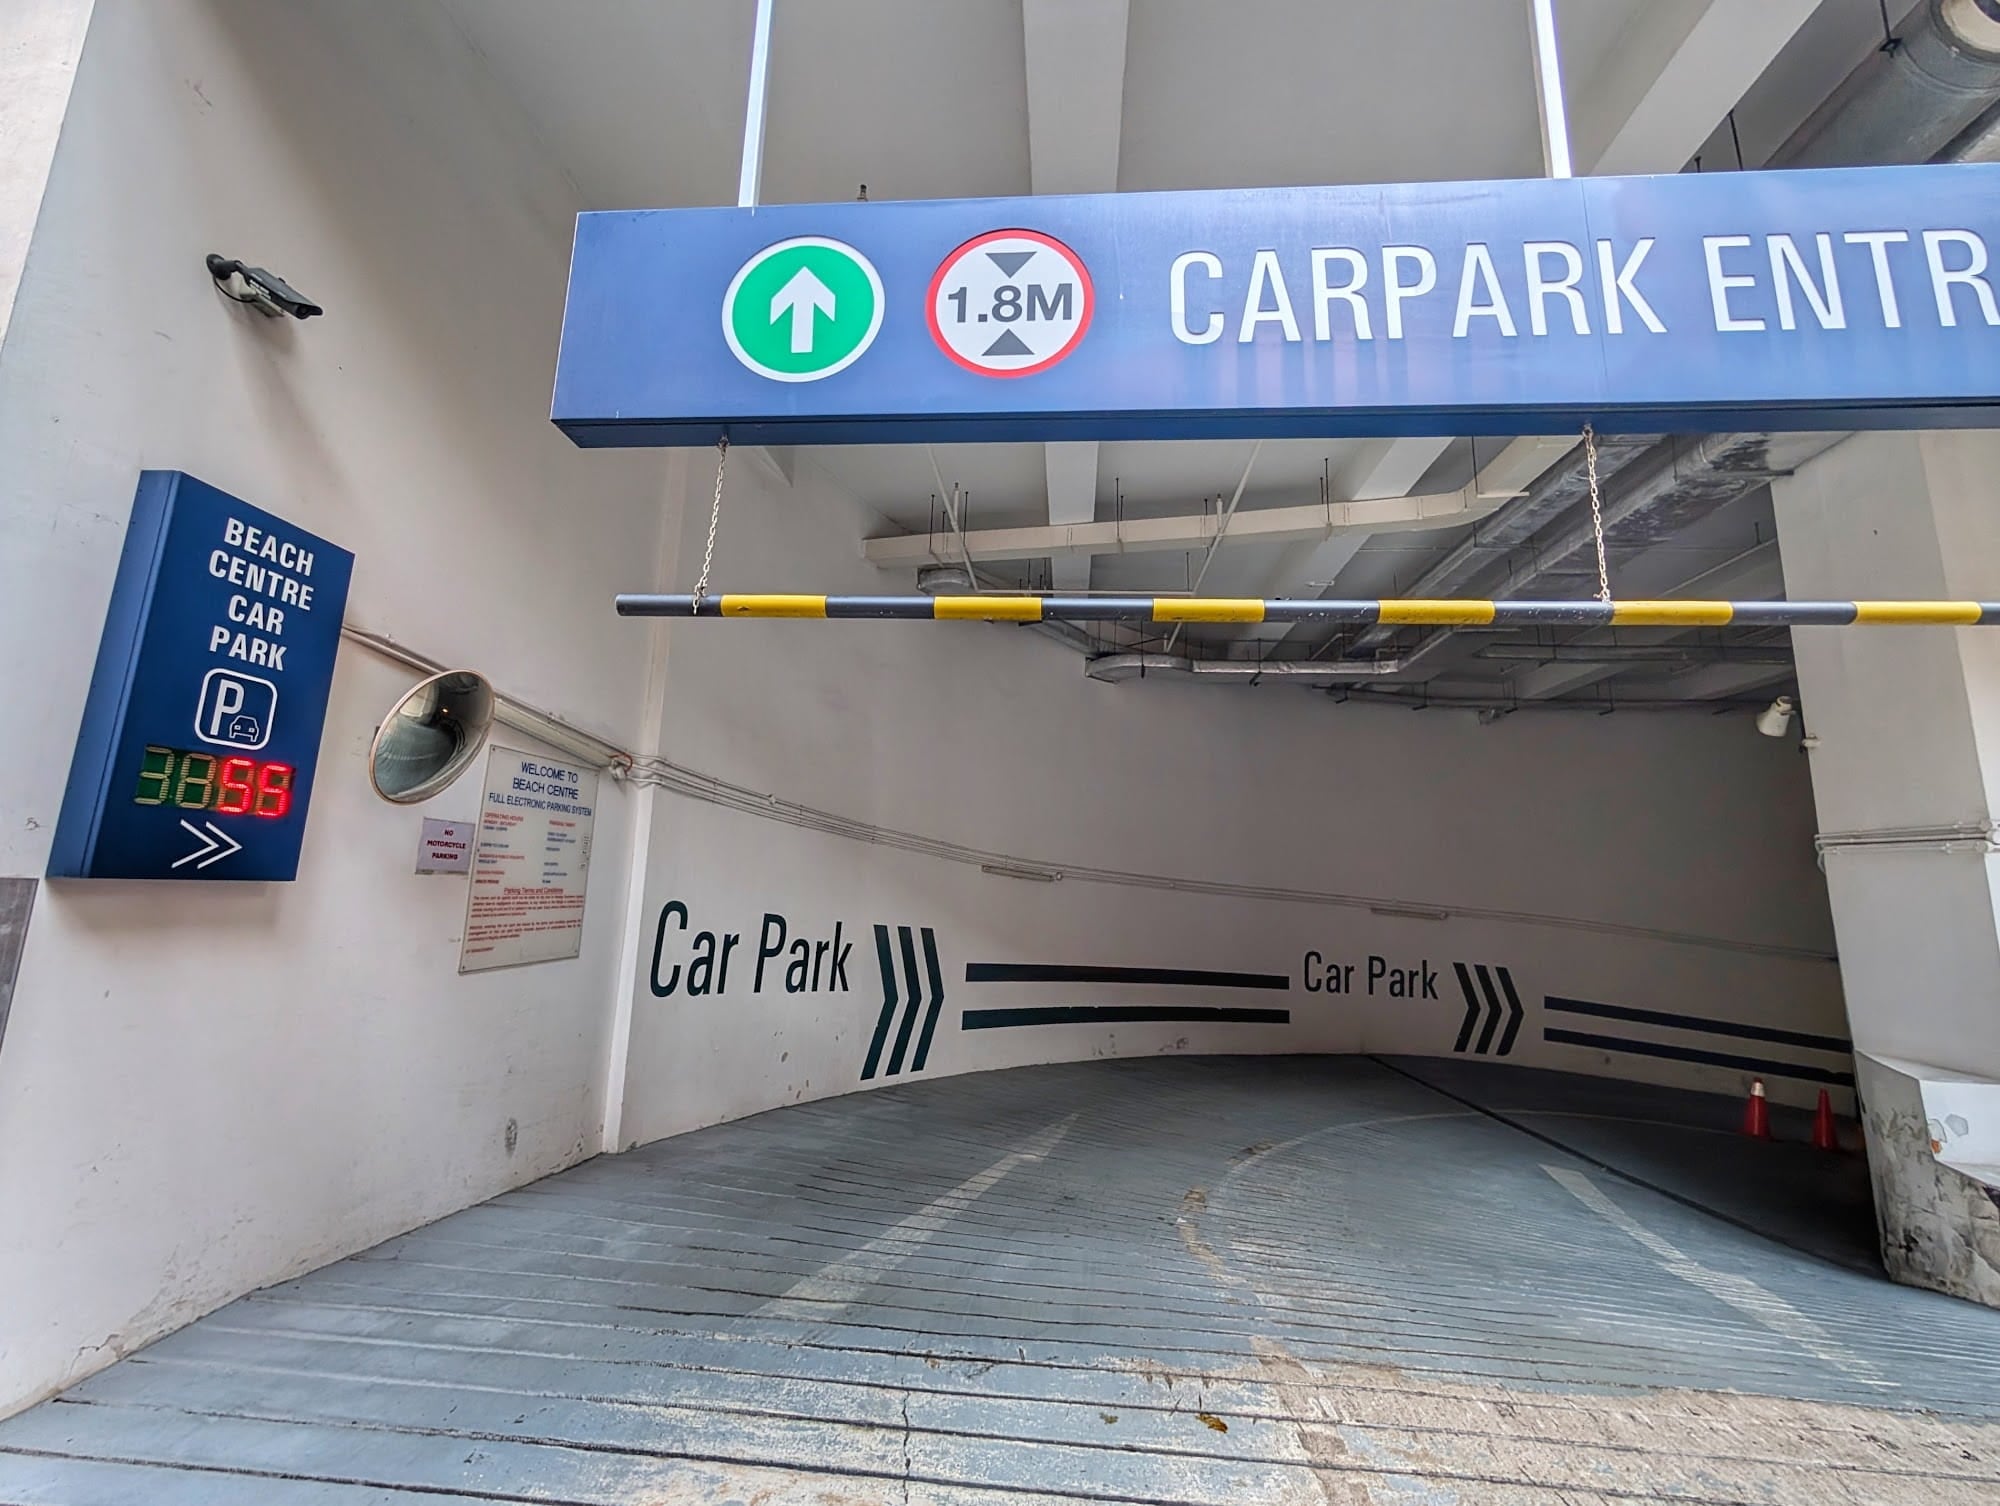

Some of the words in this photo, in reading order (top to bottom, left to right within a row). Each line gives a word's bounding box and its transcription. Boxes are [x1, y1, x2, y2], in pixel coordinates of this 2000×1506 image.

[947, 283, 1073, 323] 1.8M
[1169, 236, 1668, 345] CARPARK
[1702, 228, 2000, 333] ENTR
[224, 517, 314, 577] BEACH
[209, 549, 314, 611] CENTRE
[228, 594, 285, 636] CAR
[209, 625, 287, 671] PARK
[512, 777, 545, 794] BEACH
[546, 784, 579, 800] CENTRE
[521, 761, 566, 781] WELCOME
[567, 771, 579, 783] TO
[488, 792, 505, 804] FULL
[506, 795, 546, 811] ELECTRONIC
[546, 801, 571, 814] PARKING
[571, 805, 592, 817] SYSTEM
[426, 840, 466, 849] MOTORCYCLE
[444, 829, 454, 837] NO
[431, 852, 458, 860] PARKING
[650, 900, 740, 998] Car
[753, 913, 853, 994] Park
[1304, 951, 1355, 995] Car
[1368, 955, 1439, 1000] Park
